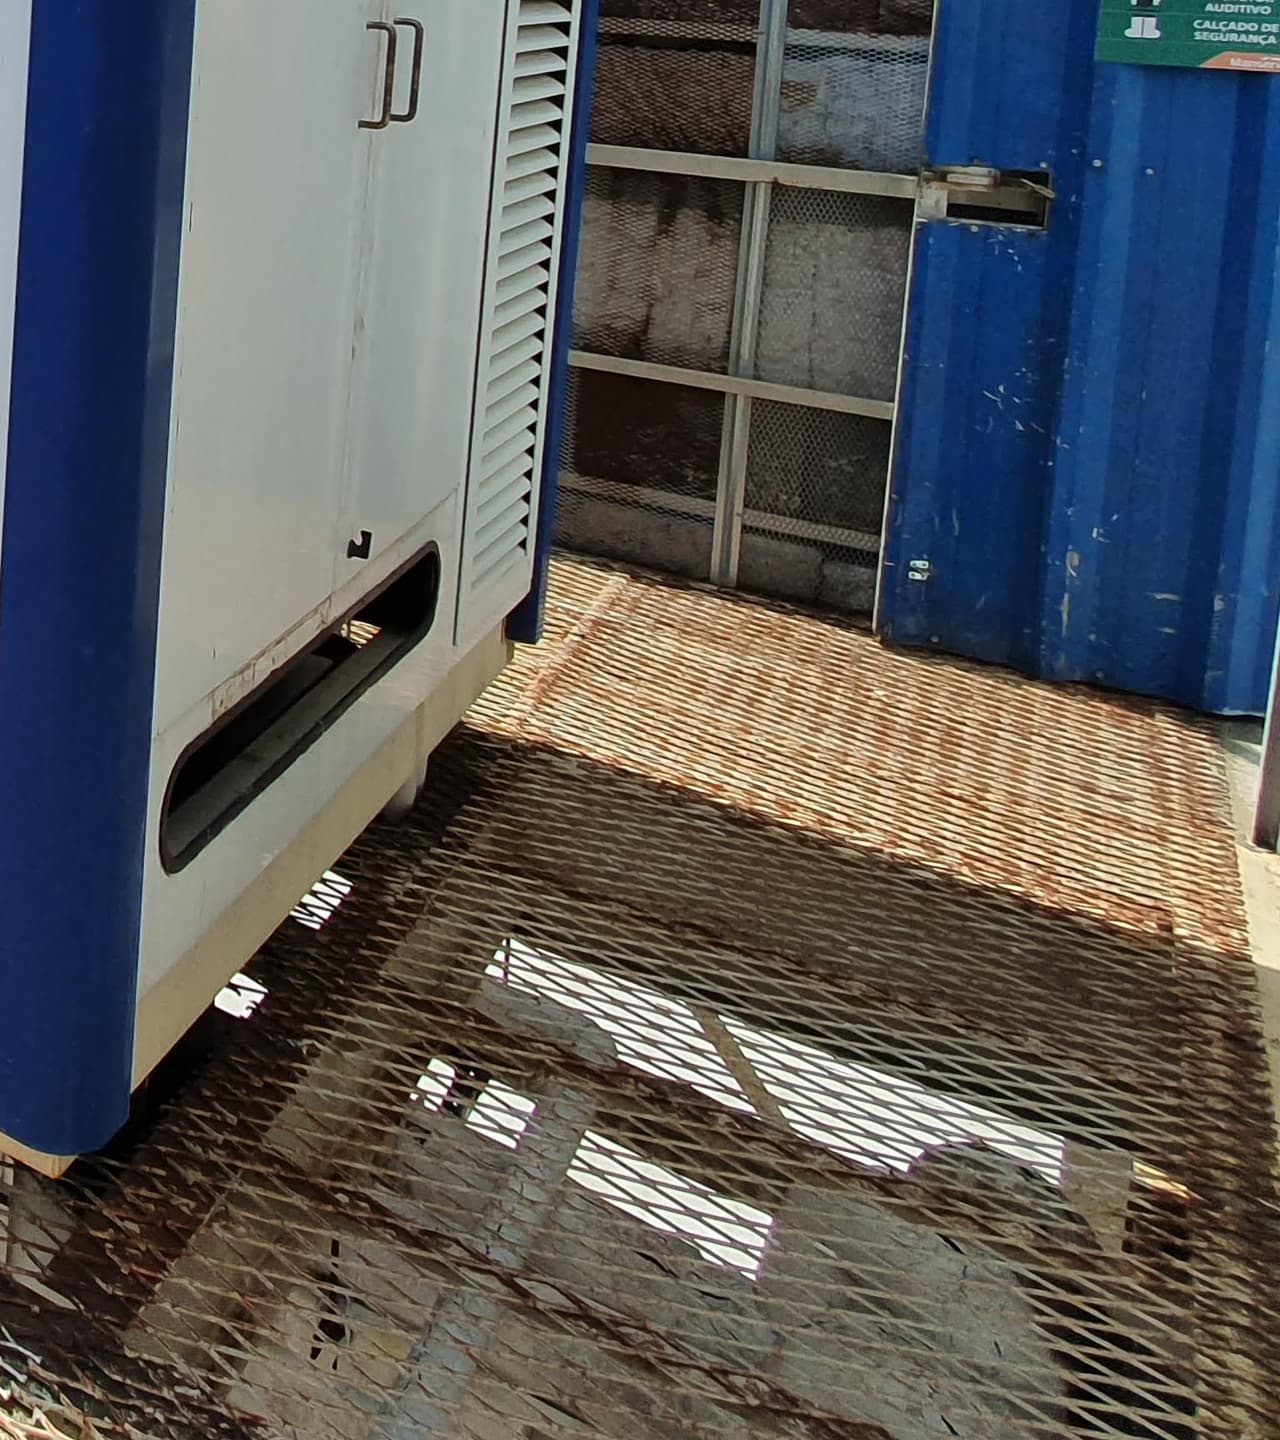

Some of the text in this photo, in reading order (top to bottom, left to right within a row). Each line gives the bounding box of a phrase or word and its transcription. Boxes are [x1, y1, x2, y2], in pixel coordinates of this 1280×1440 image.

[1205, 3, 1272, 14] AUDITIVO
[1193, 20, 1280, 32] CALÇADO DE
[1193, 31, 1277, 45] SEGURANÇA
